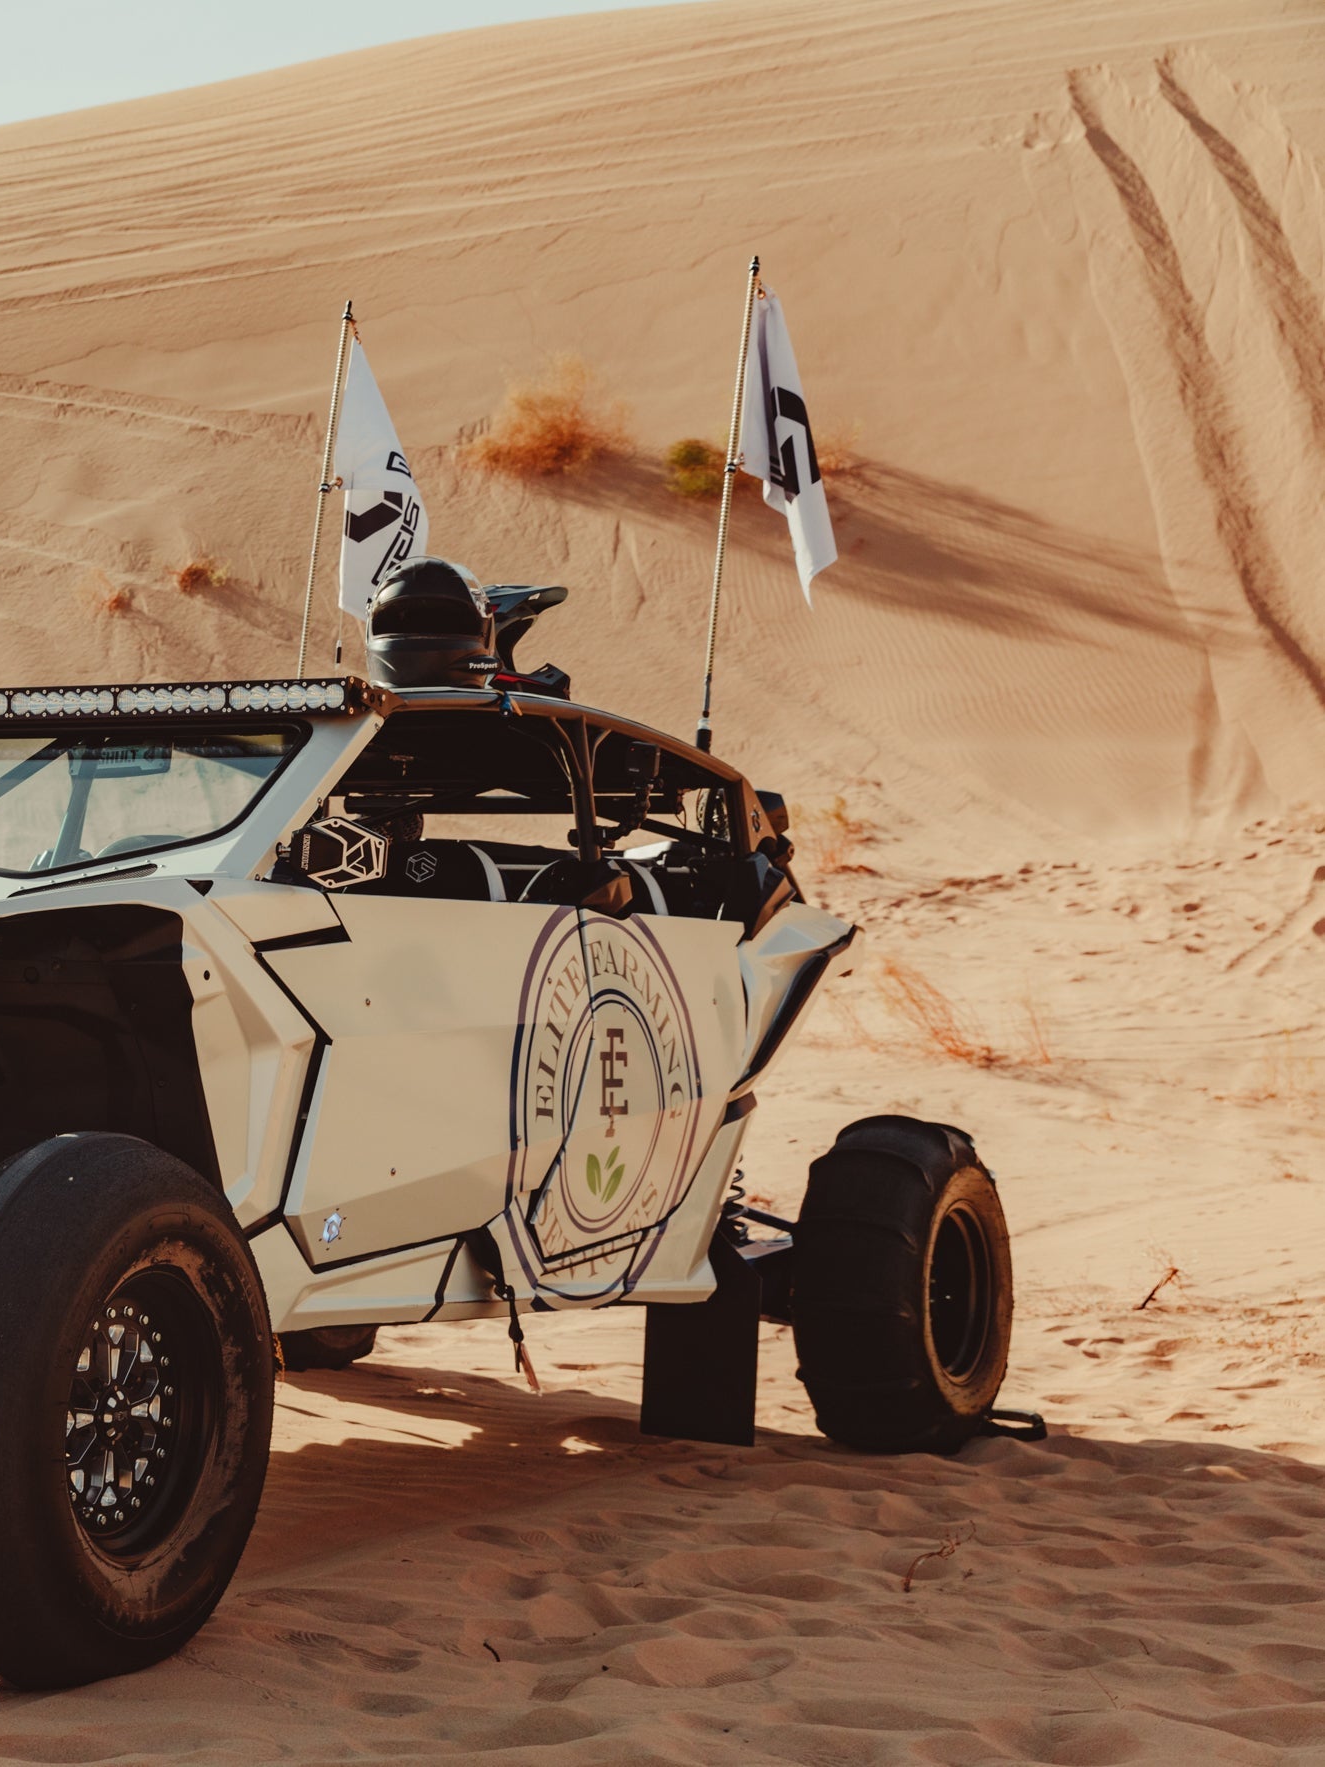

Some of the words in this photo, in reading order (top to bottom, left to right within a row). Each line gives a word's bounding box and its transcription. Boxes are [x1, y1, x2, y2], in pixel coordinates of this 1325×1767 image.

[468, 662, 498, 670] ProSport
[535, 954, 588, 1124] ELITE
[587, 940, 685, 1120] FARMING
